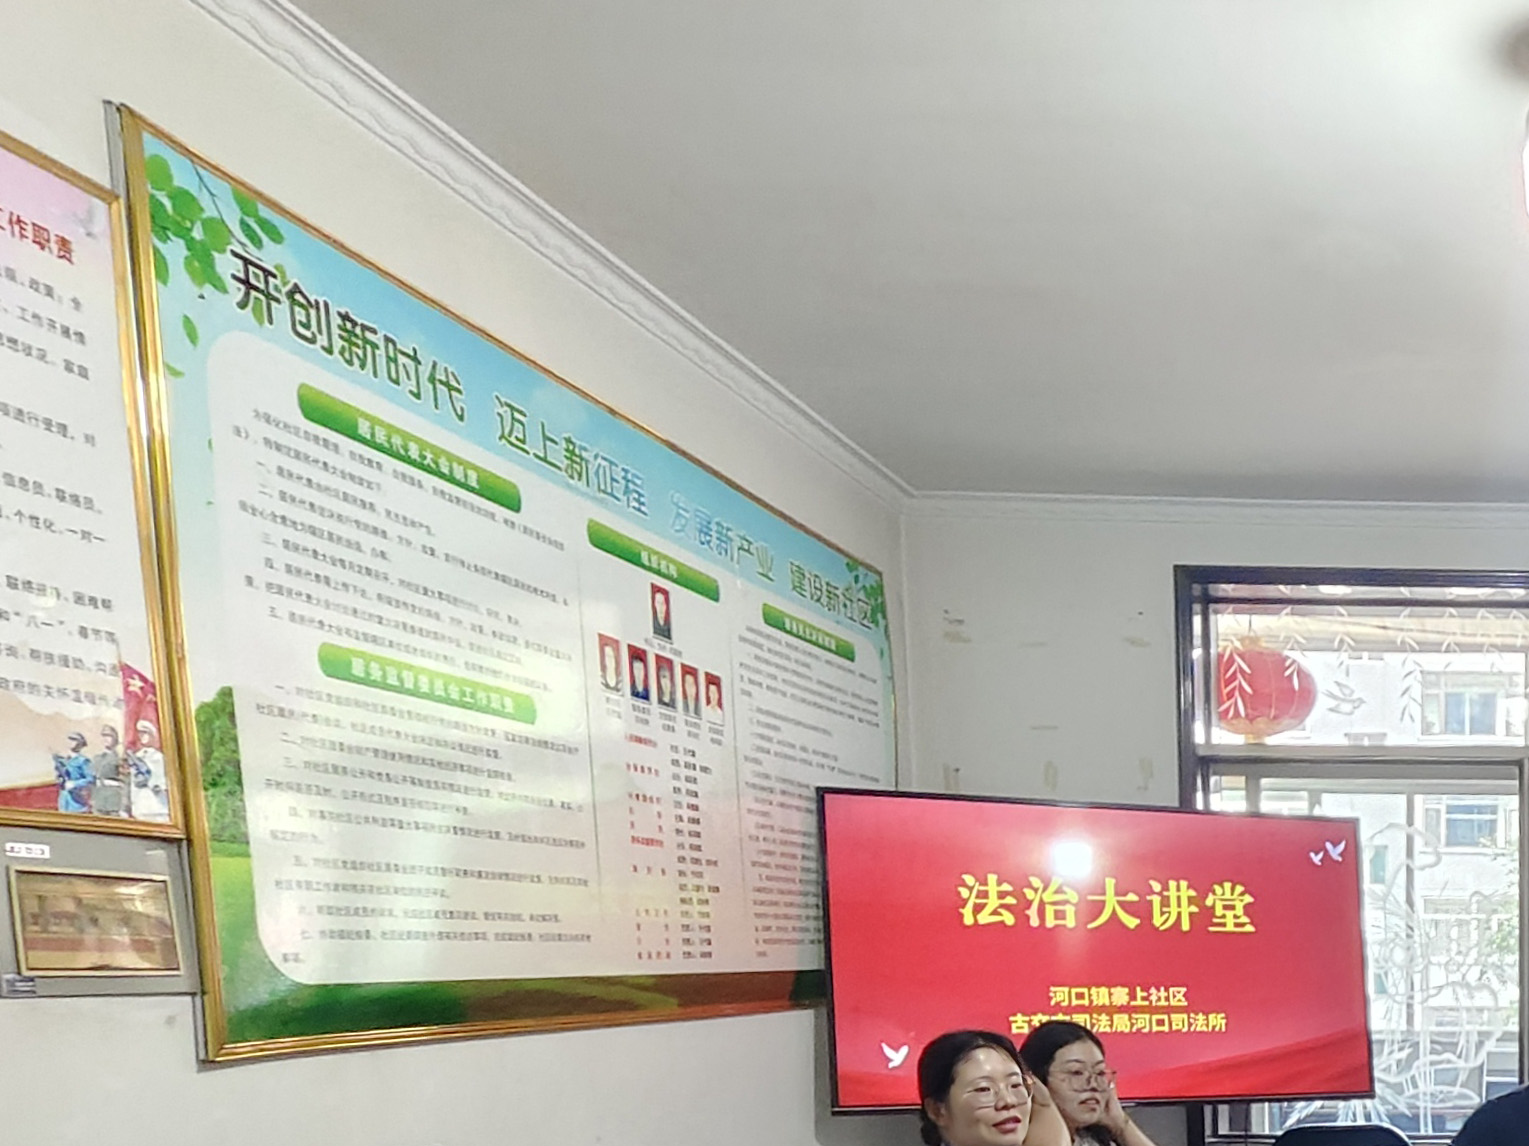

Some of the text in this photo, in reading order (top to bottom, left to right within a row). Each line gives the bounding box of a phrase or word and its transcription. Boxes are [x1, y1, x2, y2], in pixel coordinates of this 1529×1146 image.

[230, 248, 465, 422] 开创新时代
[494, 393, 650, 518] 迈上新征程
[669, 490, 776, 583] 发展新产业
[788, 559, 874, 630] 建设新社区
[357, 417, 481, 490] 居民代表大会制度
[957, 873, 1257, 934] 法治大讲堂
[1049, 985, 1188, 1007] 河口镇寨上社区
